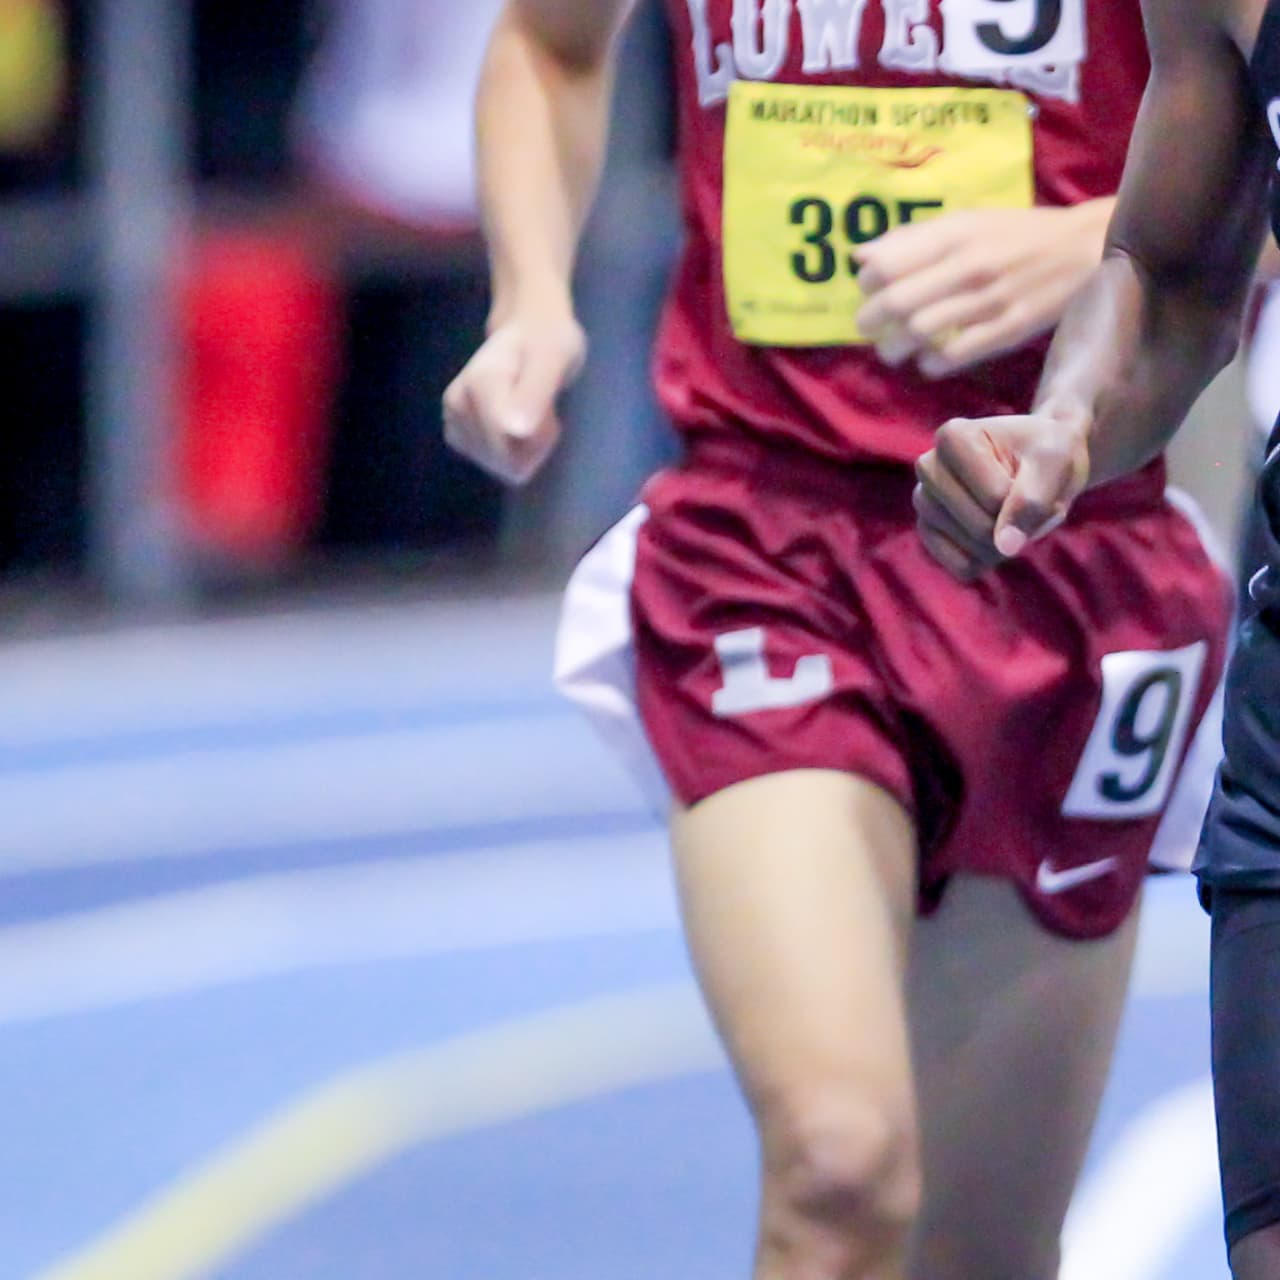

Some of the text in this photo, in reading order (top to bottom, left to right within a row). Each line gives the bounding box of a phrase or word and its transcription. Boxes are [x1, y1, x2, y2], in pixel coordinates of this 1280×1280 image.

[750, 99, 991, 126] MARATHON SPORTS
[1099, 667, 1181, 802] 9
